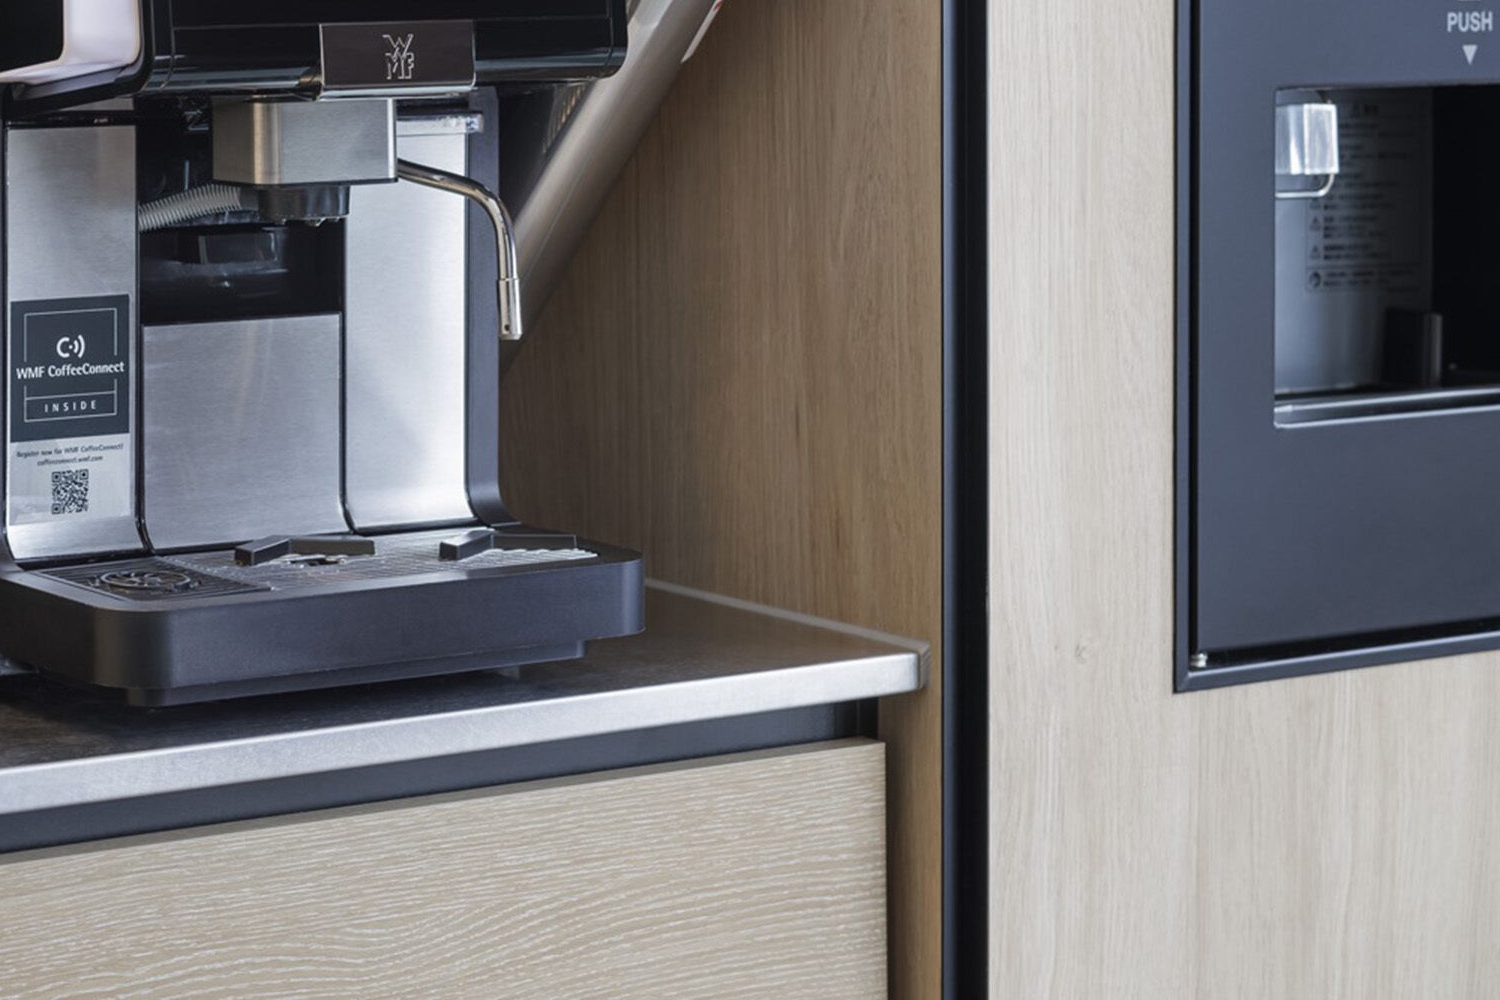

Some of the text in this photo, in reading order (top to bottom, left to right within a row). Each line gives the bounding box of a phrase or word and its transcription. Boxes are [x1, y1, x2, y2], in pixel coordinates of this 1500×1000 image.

[1446, 11, 1493, 33] PUSH
[16, 361, 125, 380] WMF CoffeeConnect
[44, 400, 97, 413] INSIDE
[16, 450, 39, 458] Register
